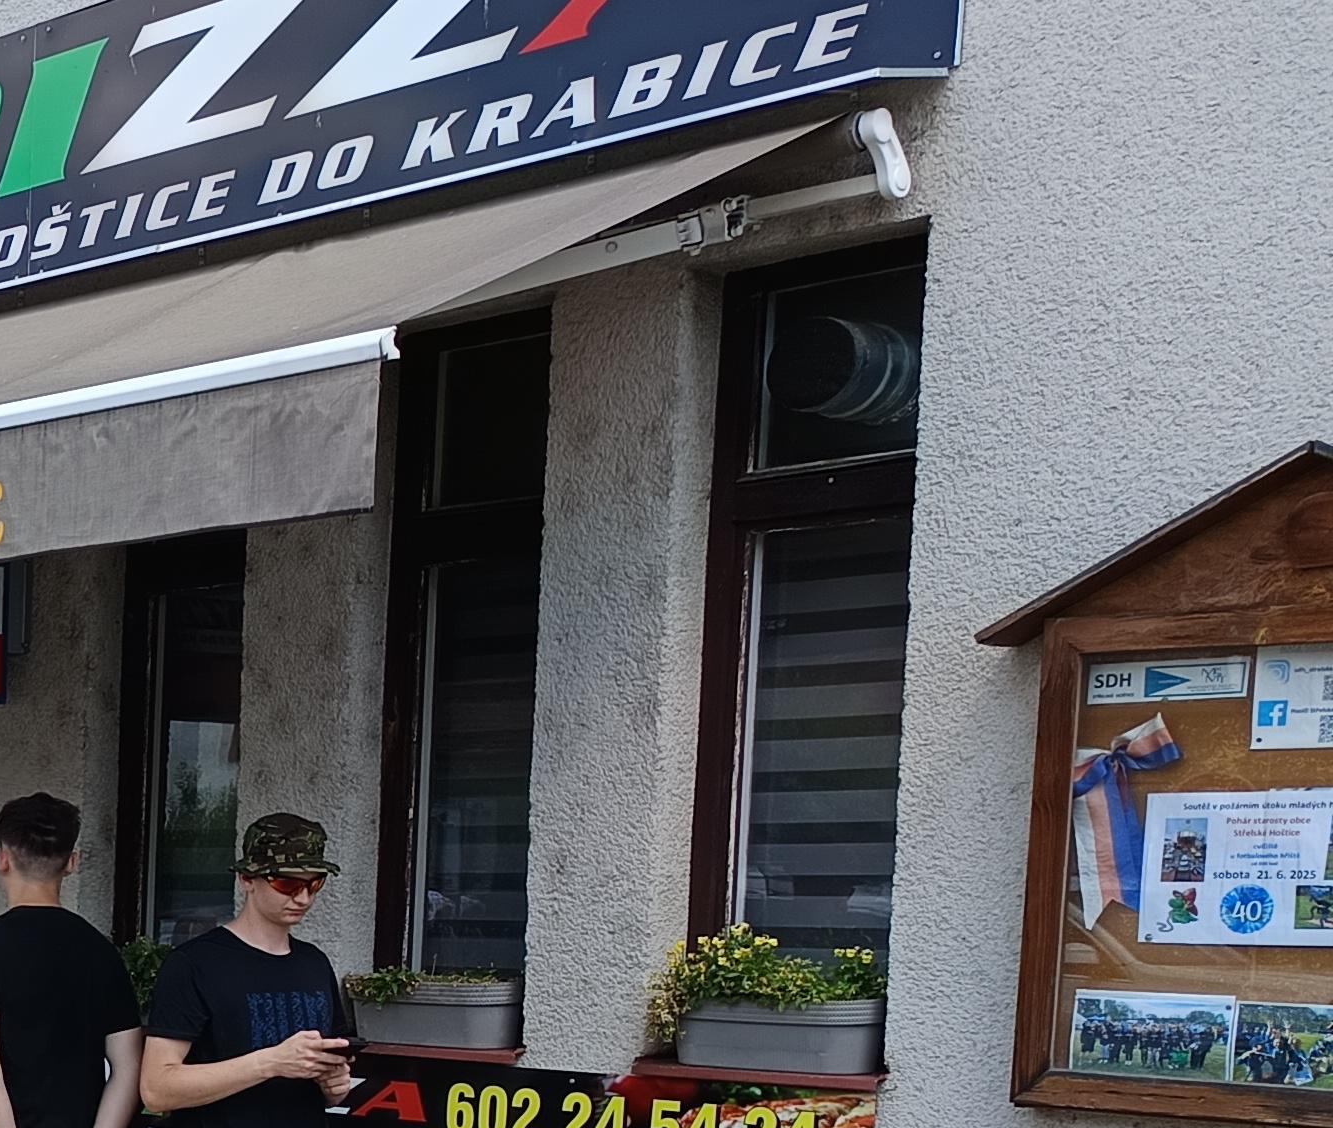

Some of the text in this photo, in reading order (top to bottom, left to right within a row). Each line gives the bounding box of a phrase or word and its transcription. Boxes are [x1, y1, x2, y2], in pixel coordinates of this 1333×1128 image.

[258, 136, 374, 206] DO
[401, 3, 869, 170] KRABICE
[1093, 673, 1132, 689] SDH
[1183, 802, 1211, 811] Soutěž
[1289, 801, 1327, 810] mladých
[1226, 817, 1251, 825] Pohár
[1253, 817, 1288, 826] starosty
[1213, 870, 1317, 880] sobota 21. 6. 2025
[1234, 900, 1263, 922] 40
